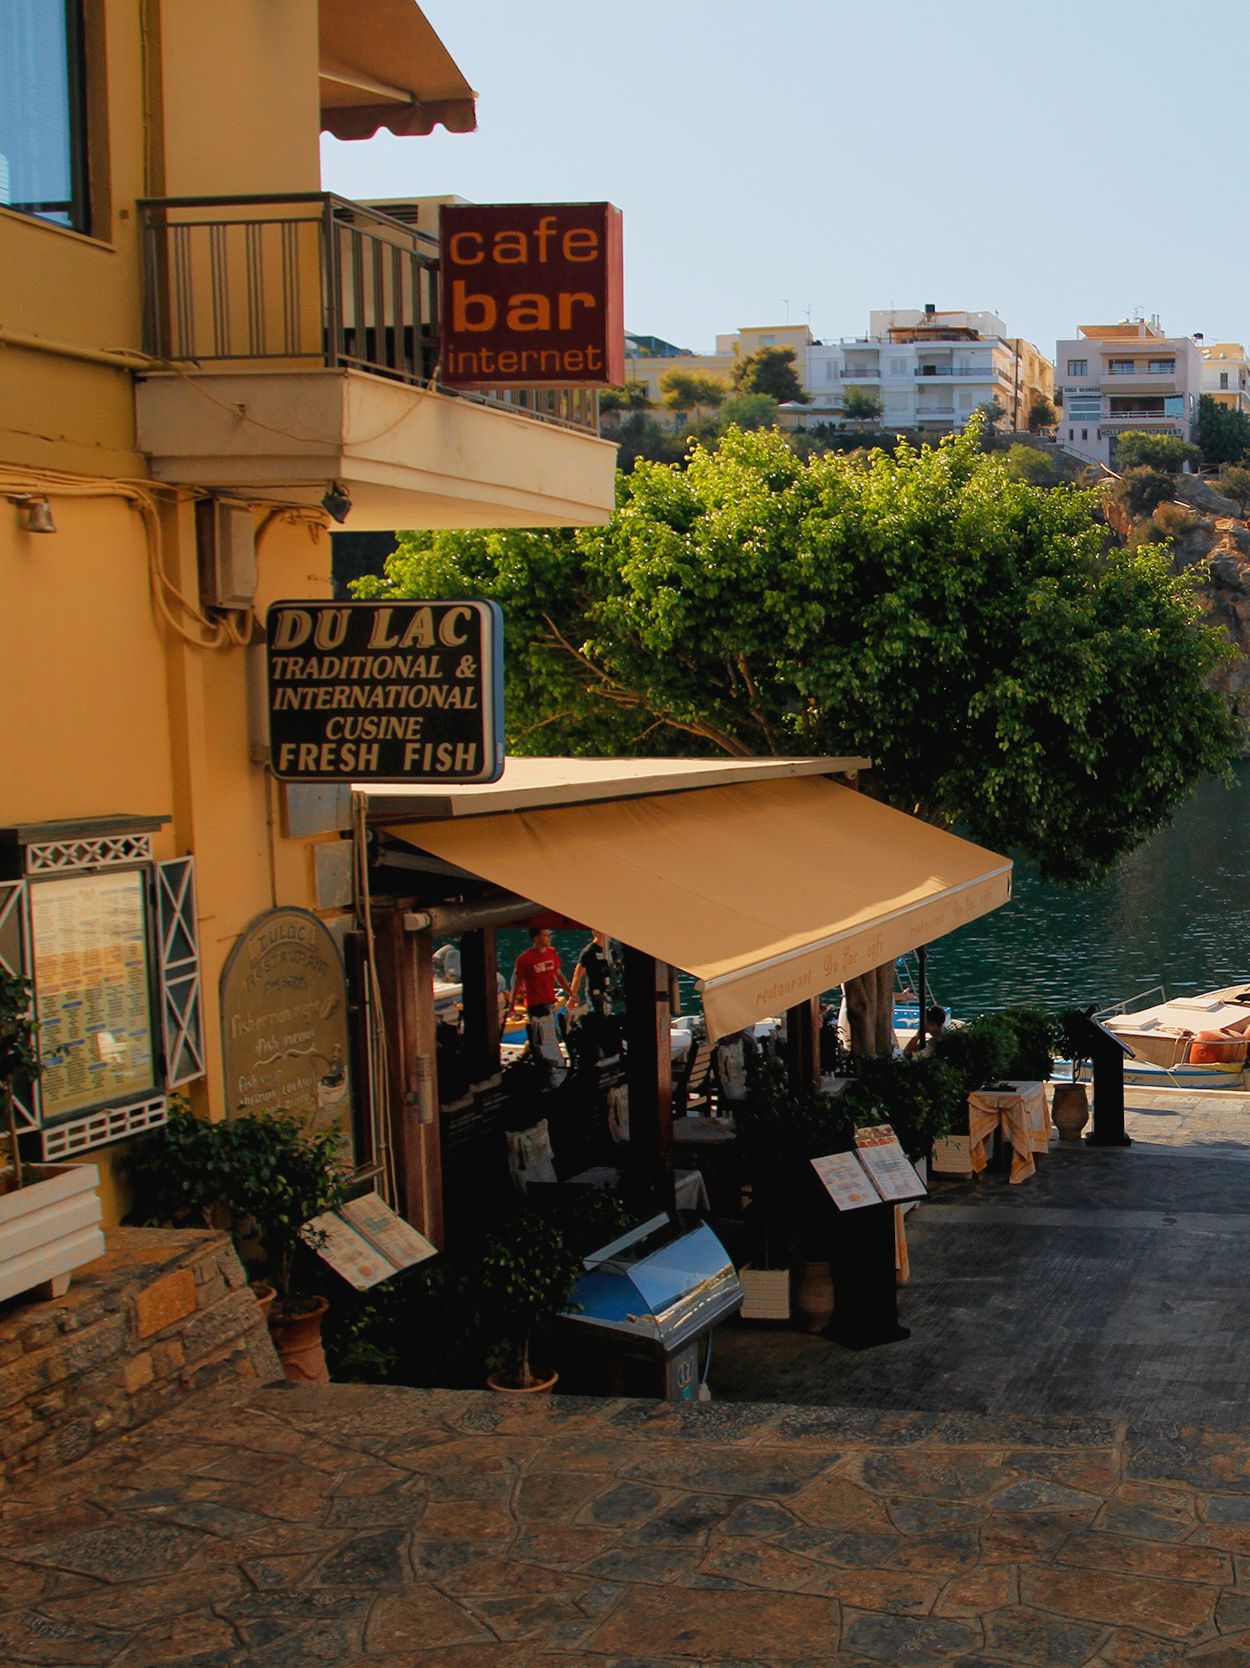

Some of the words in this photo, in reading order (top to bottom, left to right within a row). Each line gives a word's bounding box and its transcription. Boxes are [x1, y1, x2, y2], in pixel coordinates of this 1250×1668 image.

[450, 215, 599, 266] cafe
[453, 280, 596, 332] bar
[449, 344, 601, 374] internet
[272, 608, 352, 650] DU
[367, 606, 472, 650] LAC
[272, 655, 442, 680] TRADITIONAL
[455, 654, 477, 679] &
[272, 684, 478, 711] INTERNATIONAL
[325, 715, 424, 741] CUSINE
[278, 743, 380, 772] FRESH
[403, 742, 478, 772] FISH
